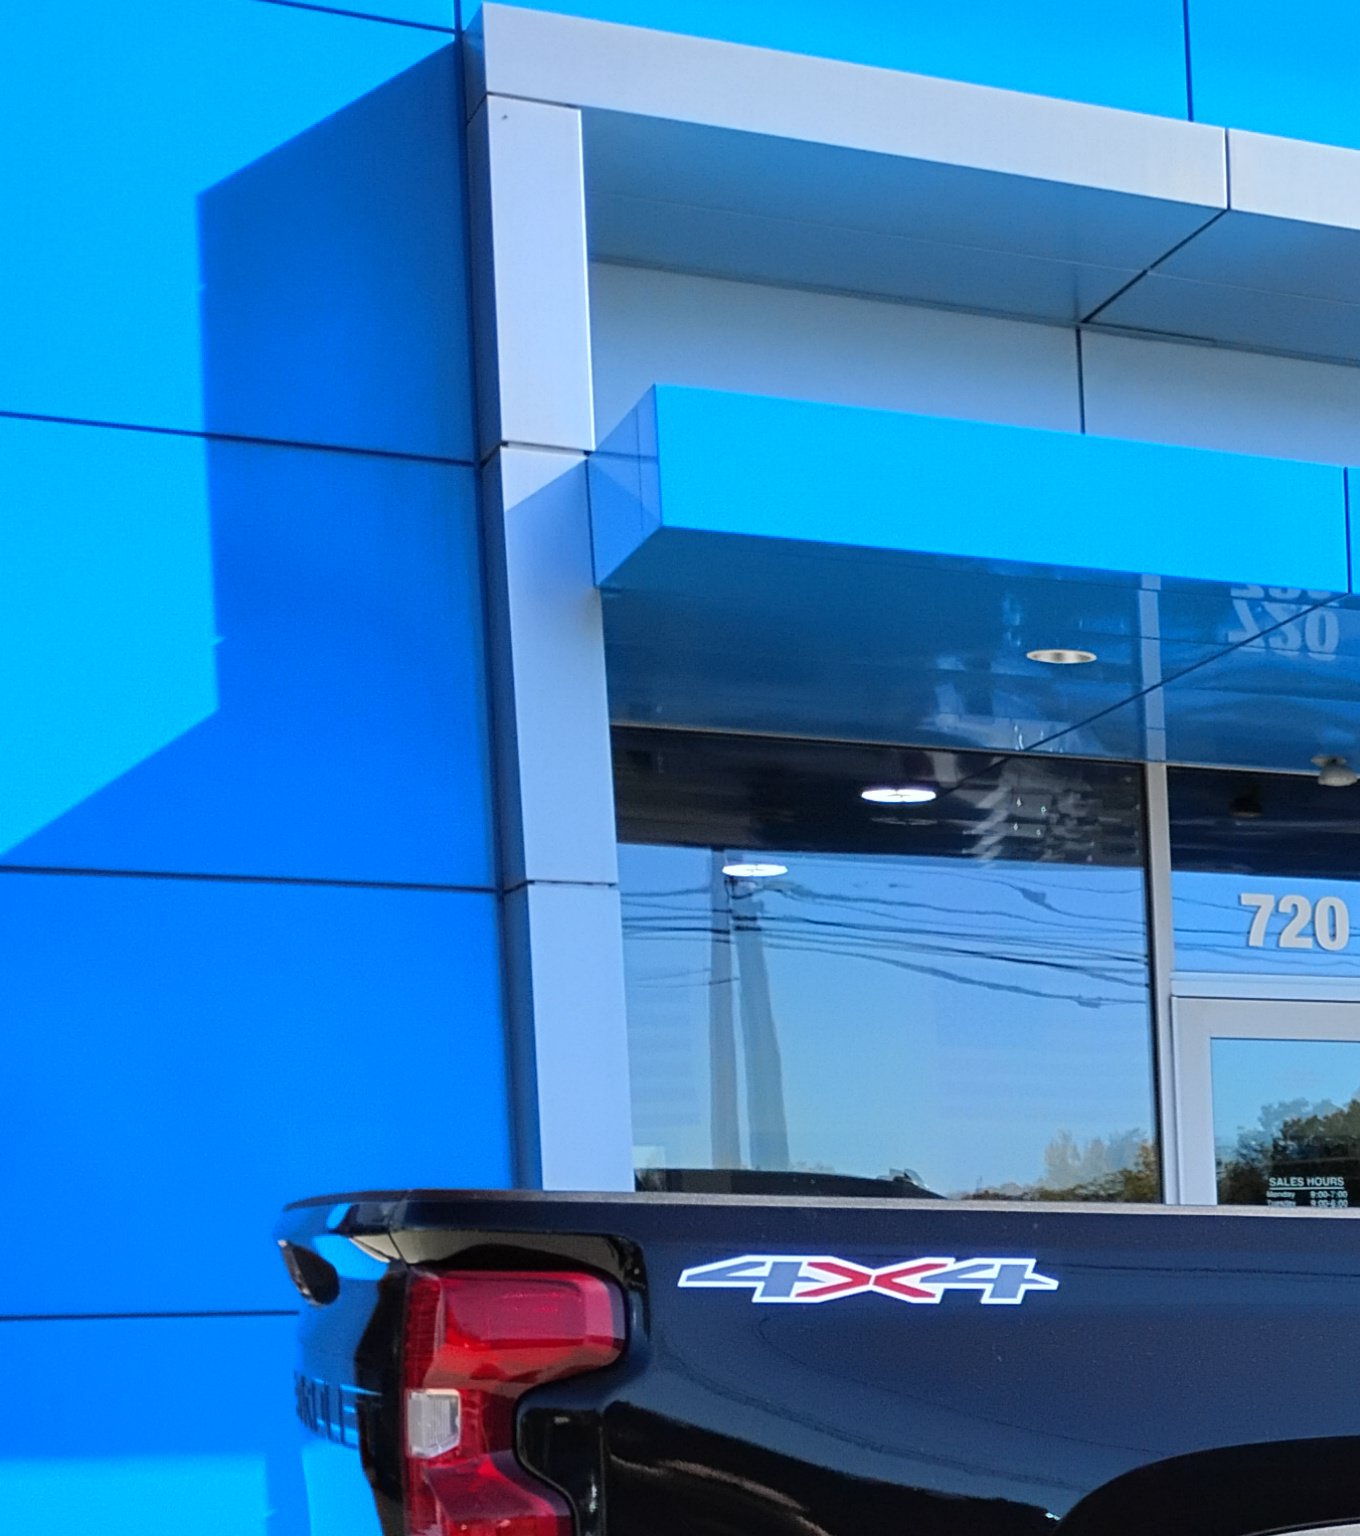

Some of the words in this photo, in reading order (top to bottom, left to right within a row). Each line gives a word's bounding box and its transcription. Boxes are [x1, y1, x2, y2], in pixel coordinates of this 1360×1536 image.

[1240, 893, 1349, 951] 720
[1268, 1177, 1305, 1187] SALES
[1306, 1177, 1345, 1187] HOURS
